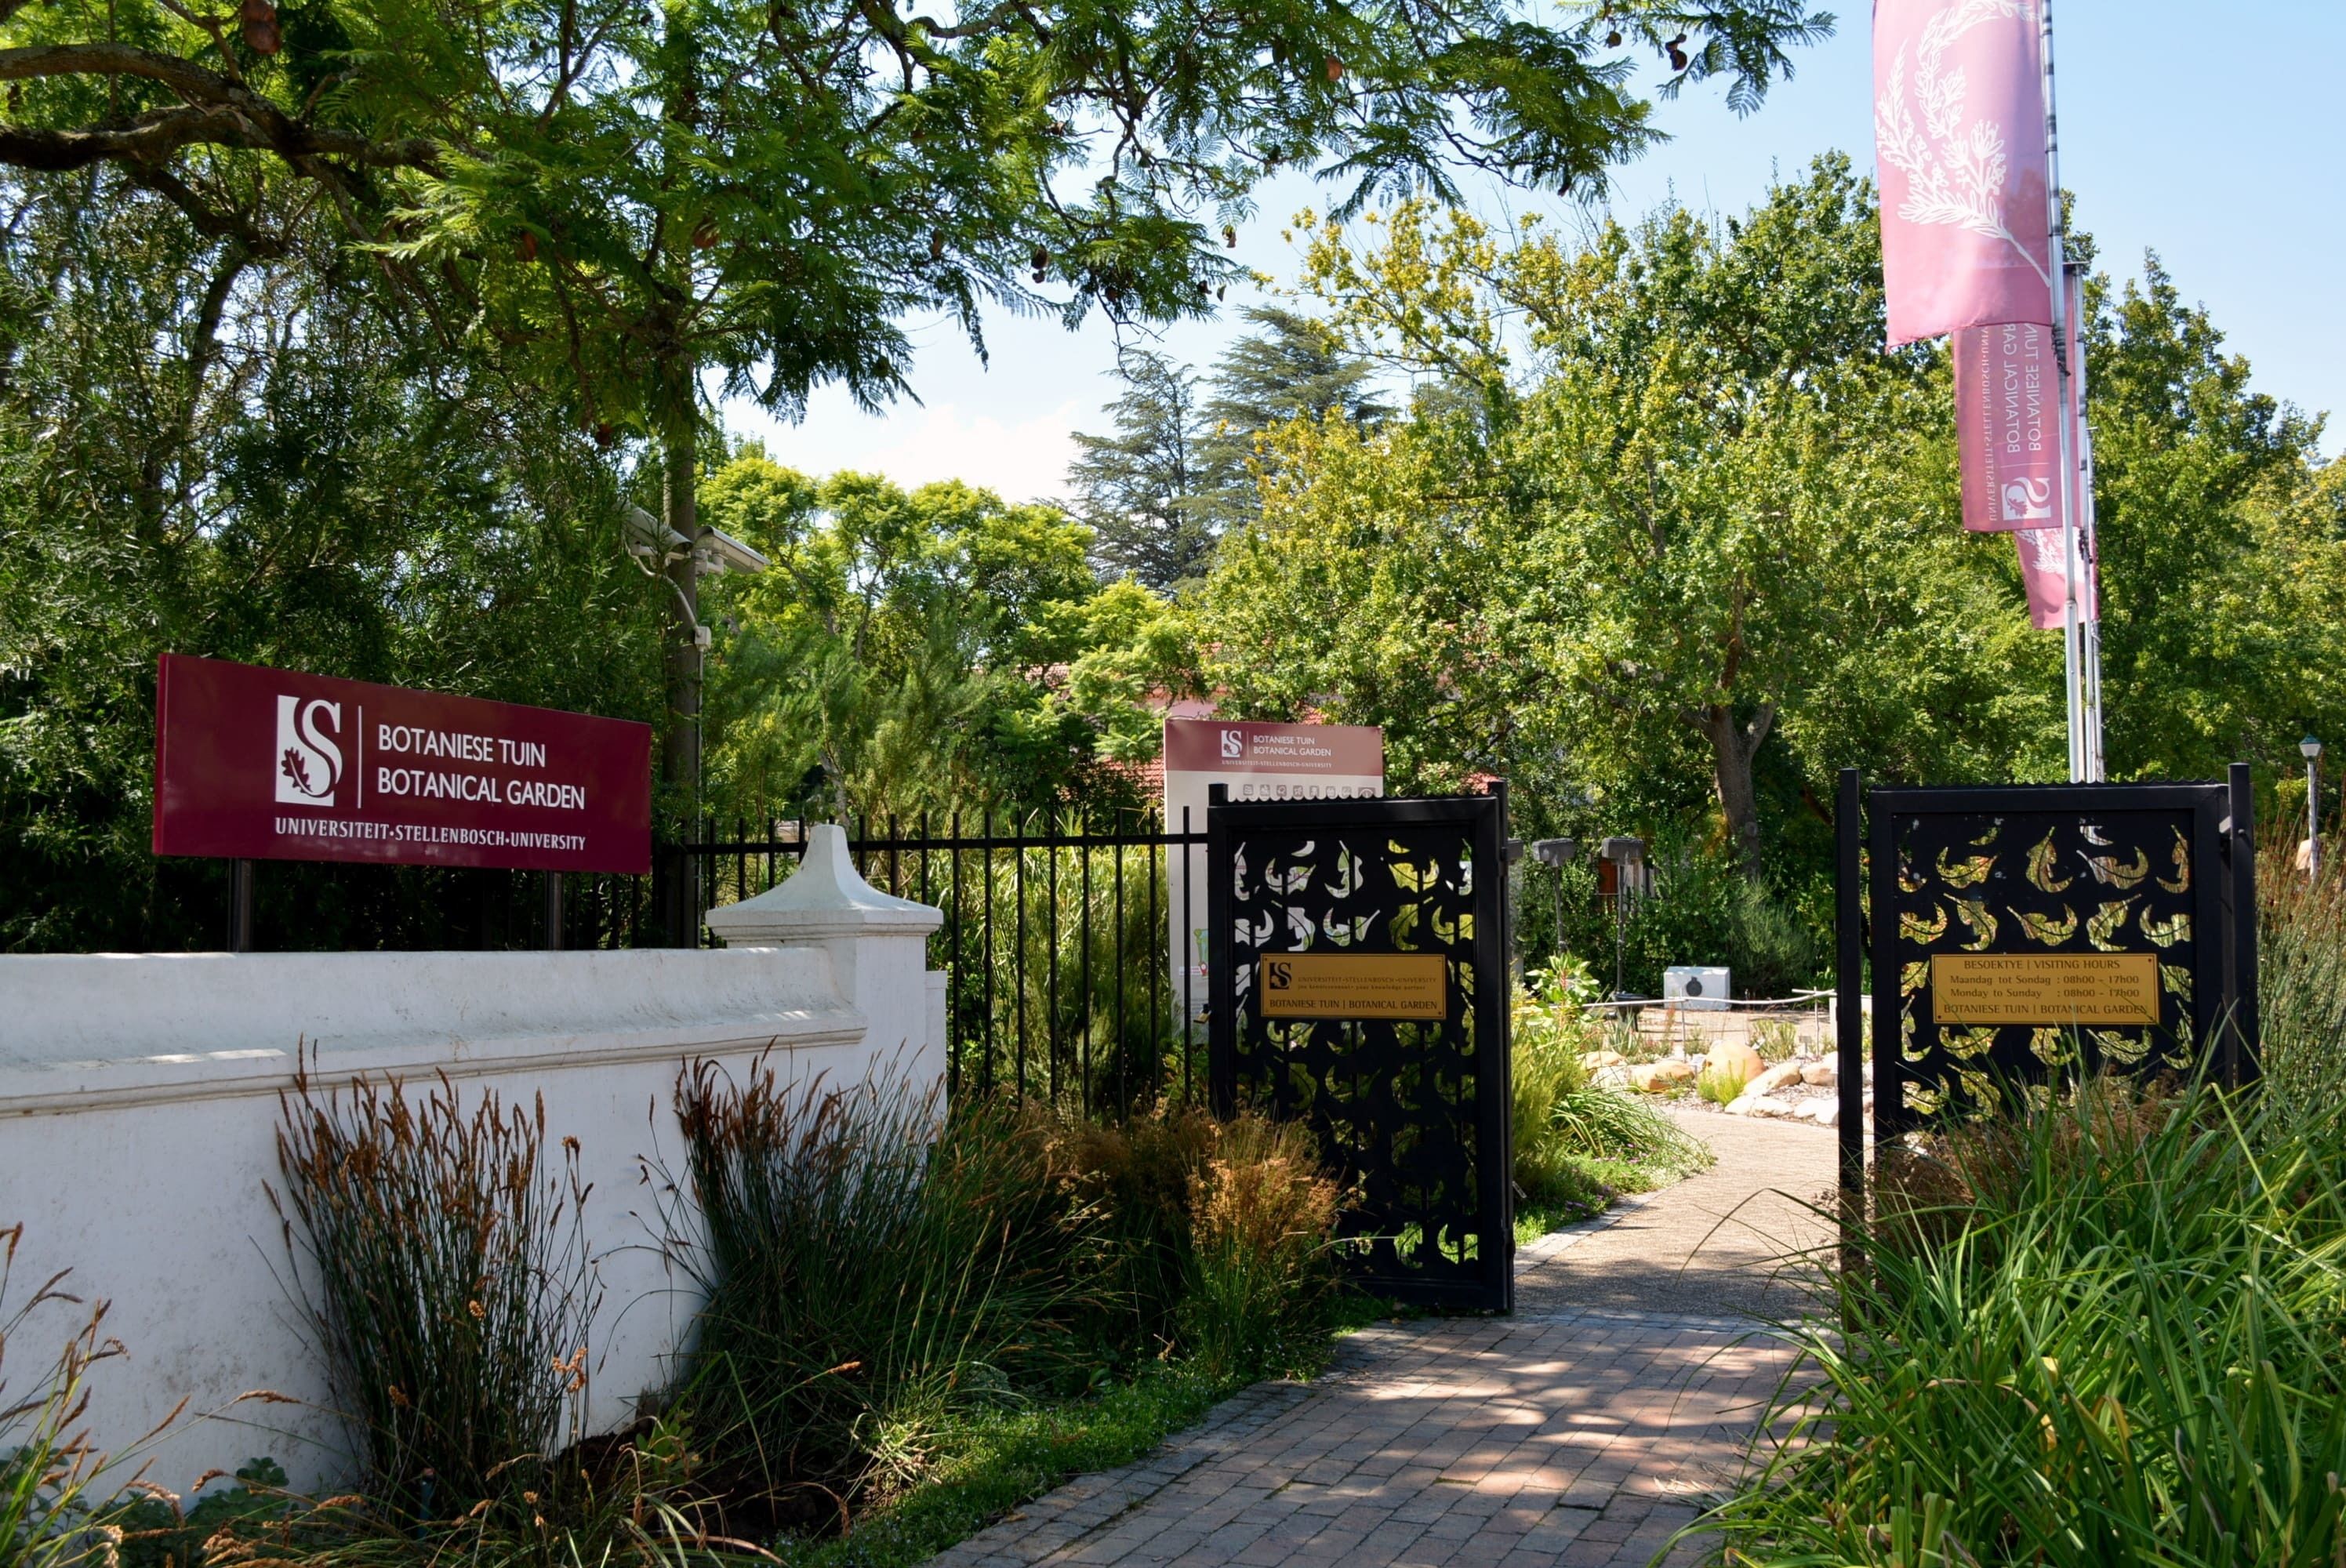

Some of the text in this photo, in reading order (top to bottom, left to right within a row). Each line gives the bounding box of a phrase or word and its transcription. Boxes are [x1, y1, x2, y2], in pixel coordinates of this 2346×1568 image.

[1253, 735, 1315, 746] BOTANIESE TUIN
[377, 724, 546, 768] BOTANIESE TUIN
[1253, 746, 1331, 757] BOTANICAL GARDEN
[377, 768, 585, 811] BOTANICAL GARDEN
[1963, 960, 2023, 969] BESOEKTYE
[2034, 960, 2079, 969] VISITING
[2083, 960, 2121, 969] HOURS
[1950, 975, 1992, 985] Maandag
[2016, 975, 2051, 985] Sondag
[2063, 975, 2095, 984] 08h00
[2108, 975, 2139, 984] 17h00
[1950, 989, 1988, 999] Monday
[2006, 989, 2042, 999] Sunday
[2064, 989, 2095, 997] 08h00
[2109, 989, 2140, 997] 17h00
[1269, 1000, 1316, 1008] BOTANIESE
[1320, 1000, 1340, 1008] TUIN
[1349, 1000, 1398, 1009] BOTANICAL
[1400, 1001, 1437, 1010] GARDEN
[1944, 1004, 2000, 1014] BOTANIESE
[2004, 1004, 2029, 1014] TUIN
[2103, 1005, 2147, 1014] GARDEN
